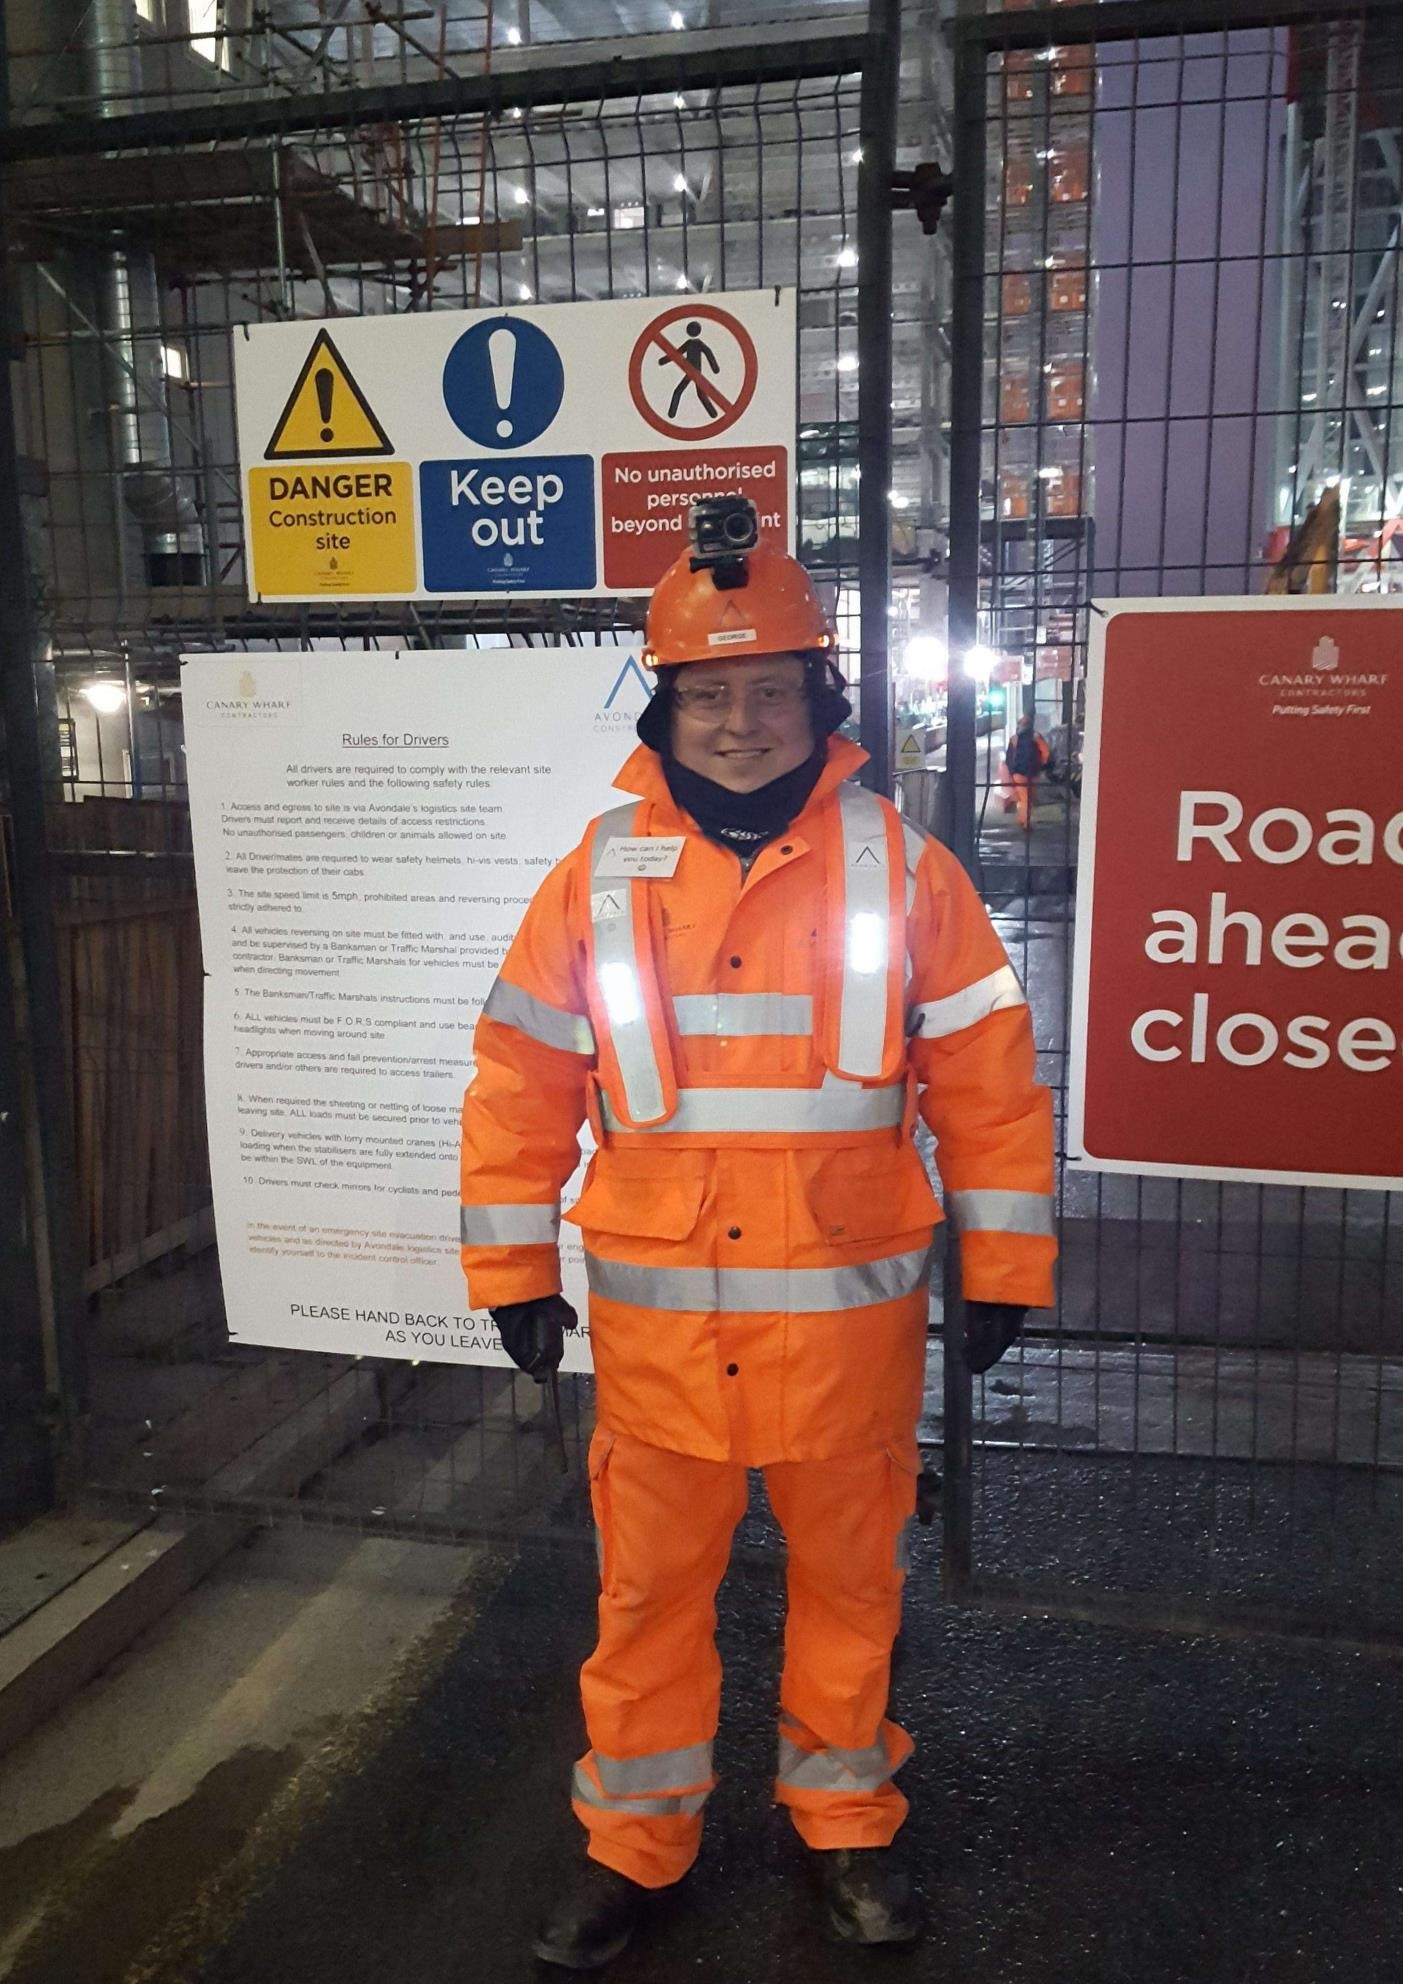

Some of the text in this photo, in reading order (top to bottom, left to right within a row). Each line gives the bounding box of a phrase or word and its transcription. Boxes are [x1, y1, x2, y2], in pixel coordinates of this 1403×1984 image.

[615, 460, 776, 483] No unauthorised
[269, 473, 393, 500] DANGER
[450, 469, 564, 511] Keep
[269, 508, 396, 527] Construction
[611, 514, 682, 535] beyond
[472, 510, 544, 547] out
[316, 532, 351, 550] site
[717, 632, 748, 642] GEORGE
[1258, 674, 1389, 686] CANARY WHARF
[1280, 689, 1366, 697] CONTRACTORS
[206, 701, 291, 710] CANARY WHARF
[1272, 704, 1372, 717] Putting Safety First
[594, 711, 640, 722] AVOND
[342, 733, 449, 745] Rules for Drivers
[286, 763, 298, 772] All
[300, 763, 332, 773] drivers
[354, 764, 394, 775] required
[397, 764, 406, 773] to
[409, 764, 444, 775] comply
[447, 764, 467, 773] with
[470, 764, 486, 773] the
[489, 764, 530, 773] relevant
[533, 764, 551, 773] site
[286, 777, 318, 786] worker
[321, 777, 344, 786] rules
[348, 777, 366, 787] and
[369, 777, 384, 787] the
[387, 777, 430, 789] following
[433, 777, 462, 789] safety
[221, 814, 251, 823] Drivers
[253, 814, 274, 823] must
[276, 815, 302, 826] report
[304, 815, 321, 824] and
[323, 816, 355, 824] receive
[358, 816, 386, 824] details
[389, 816, 398, 824] of
[222, 827, 472, 839] No unauthorised children animals allowed
[1144, 892, 1403, 970] ahea
[1130, 992, 1403, 1072] close
[290, 1303, 350, 1320] PLEASE
[355, 1309, 400, 1324] HAND
[405, 1313, 449, 1328] BACK
[453, 1316, 475, 1330] TO
[385, 1329, 503, 1351] AS YOU LEAVE
